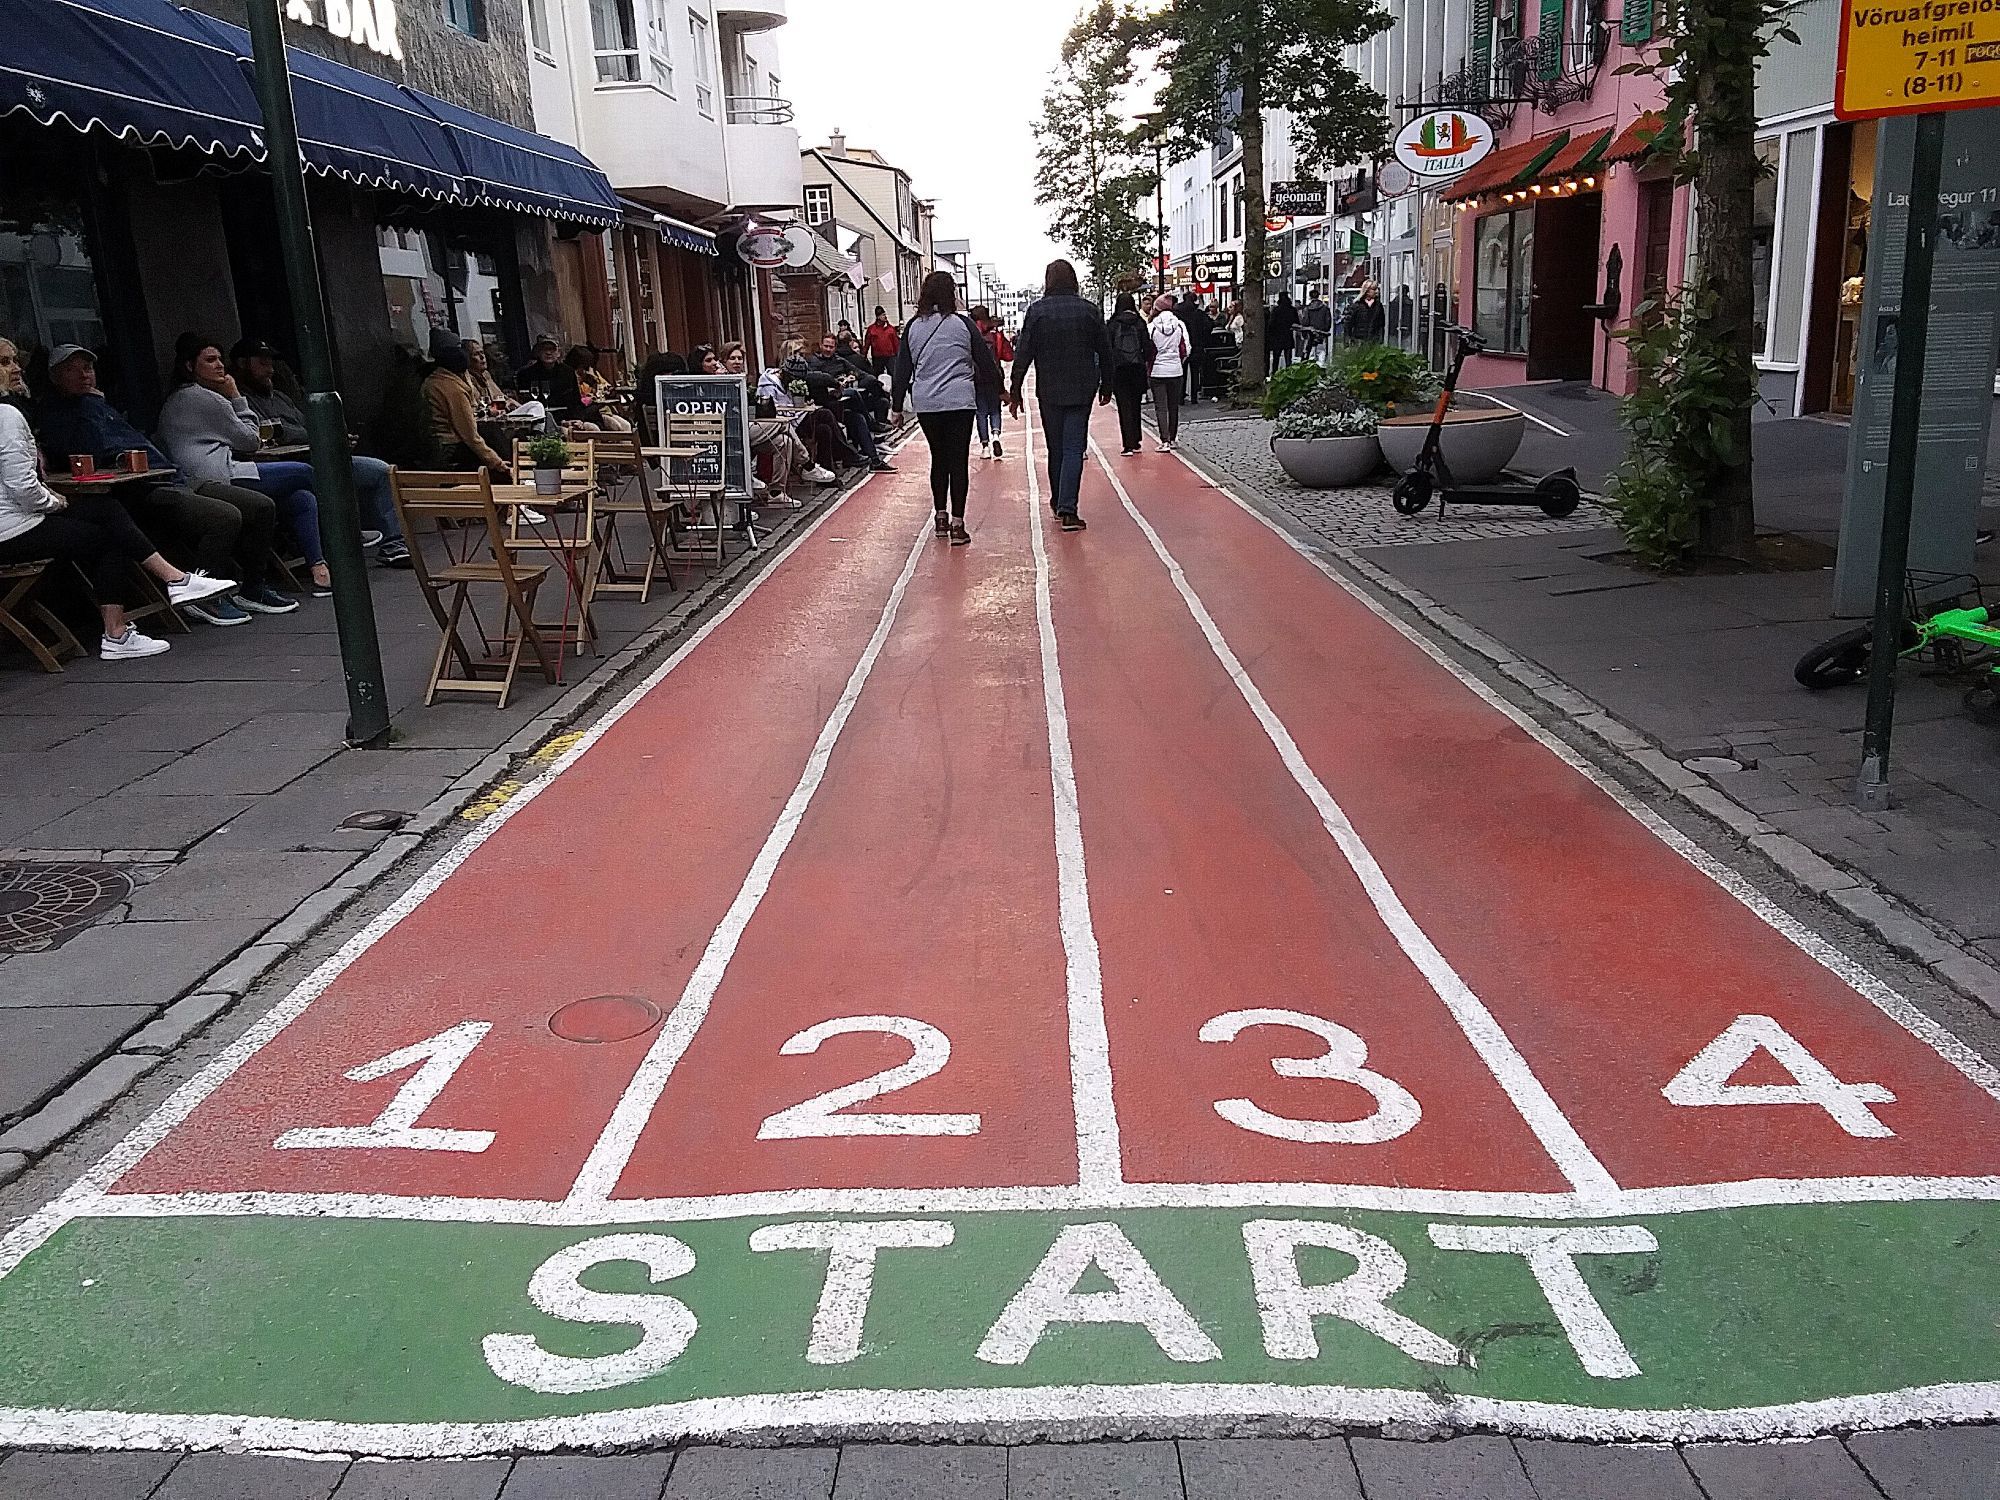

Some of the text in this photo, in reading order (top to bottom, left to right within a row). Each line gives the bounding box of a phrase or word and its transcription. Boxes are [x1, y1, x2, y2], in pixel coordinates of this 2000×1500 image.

[1902, 21, 1975, 47] heimil
[1914, 49, 1956, 70] 7-11
[1903, 71, 1963, 97] (8-11)
[1275, 192, 1321, 205] yeoman
[1887, 187, 1997, 208] Lauegur 11
[1195, 253, 1233, 263] What's On
[675, 402, 727, 415] OPEN
[273, 1008, 1897, 1154] 1 2 3 4
[481, 1219, 1661, 1395] START
